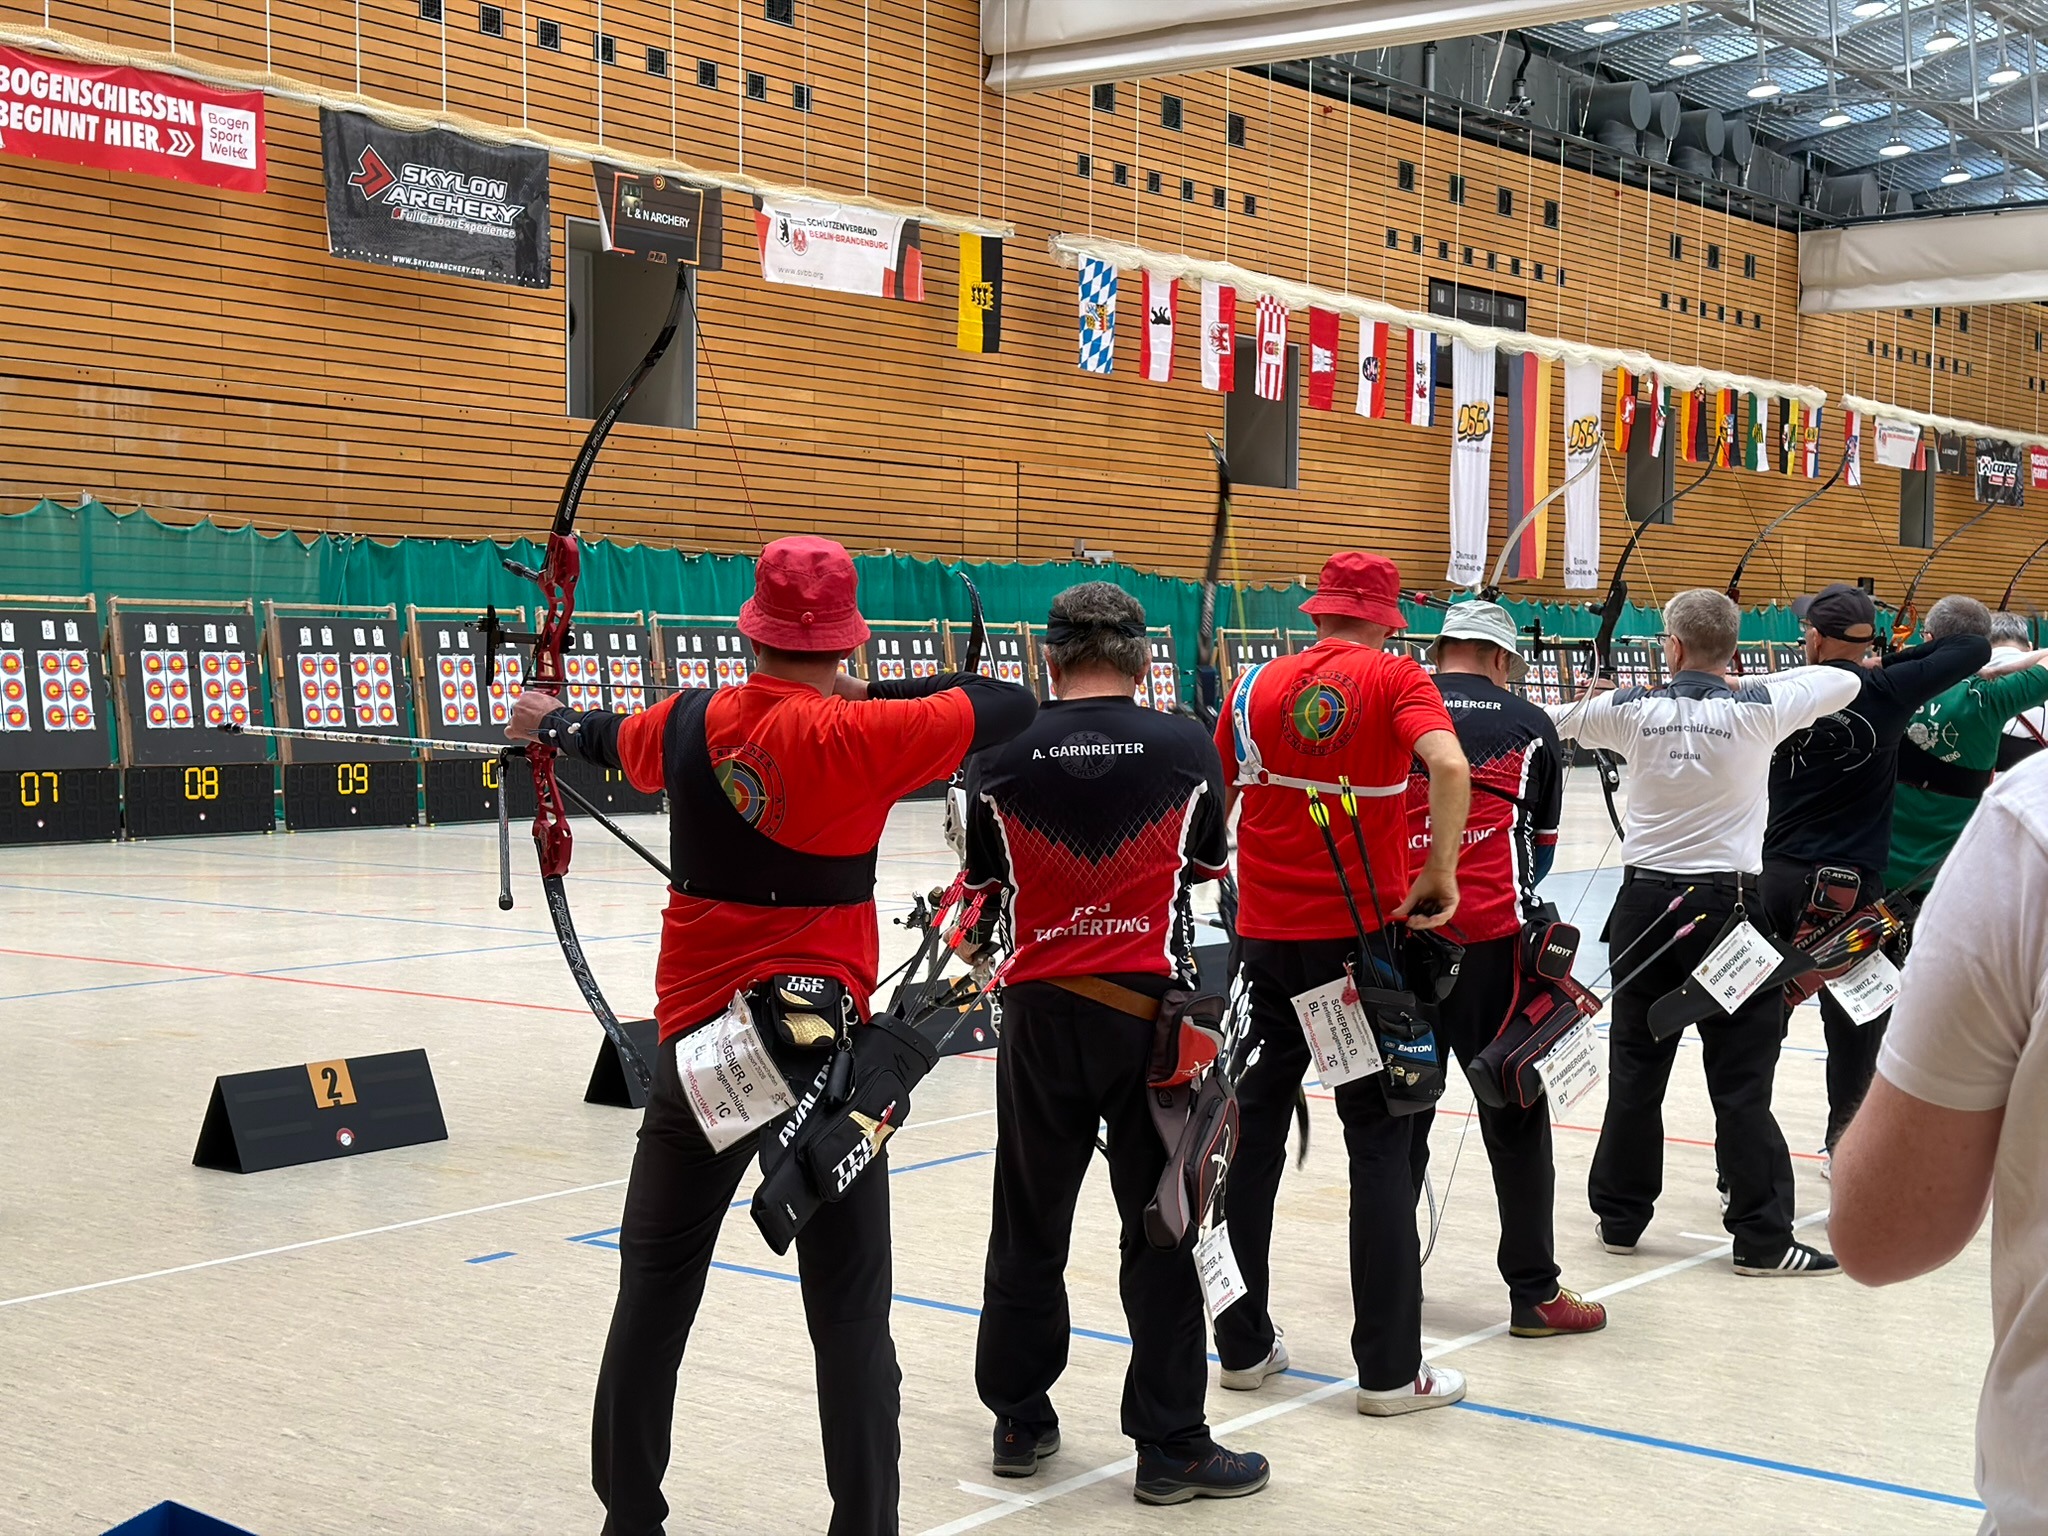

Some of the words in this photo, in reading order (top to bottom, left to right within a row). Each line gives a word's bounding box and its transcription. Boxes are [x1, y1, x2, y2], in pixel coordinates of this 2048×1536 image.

[0, 64, 196, 125] BOGENSCHIESSEN
[0, 101, 99, 142] BEGINNT
[104, 118, 165, 153] HIER.
[208, 112, 249, 131] Bogen
[209, 127, 243, 144] Sport
[210, 142, 239, 158] Welt
[401, 163, 508, 201] SKYLON
[383, 185, 525, 225] ARCHERY
[627, 207, 633, 217] L
[634, 209, 642, 219] &
[643, 209, 650, 220] N
[650, 211, 690, 228] ARCHERY
[807, 217, 878, 237] SCHÜTZENVERBAND
[809, 229, 889, 250] BERLIN-BRANDENBURG
[392, 255, 486, 276] WWW.SKYLONARCHERY.COM
[1443, 700, 1502, 711] MBERGER
[1032, 748, 1046, 760] A.
[1049, 742, 1144, 758] GARNREITER
[20, 771, 59, 807] 07
[184, 766, 219, 800] 08
[337, 763, 369, 795] 09
[1547, 942, 1573, 958] HOYT
[1723, 985, 1737, 998] NS
[1754, 955, 1766, 967] 3C
[1307, 1000, 1321, 1017] BL
[1326, 1053, 1338, 1067] 2C
[1321, 1001, 1333, 1026] Berliner
[1329, 1026, 1351, 1074] Bogenschützen
[1330, 998, 1354, 1048] SCHEPERS,
[1348, 1048, 1359, 1058] D.
[321, 1067, 343, 1099] 2
[711, 1063, 751, 1122] Bogenschützen
[741, 1082, 756, 1098] B.
[713, 1099, 731, 1119] 1C
[1556, 1089, 1571, 1104] BY
